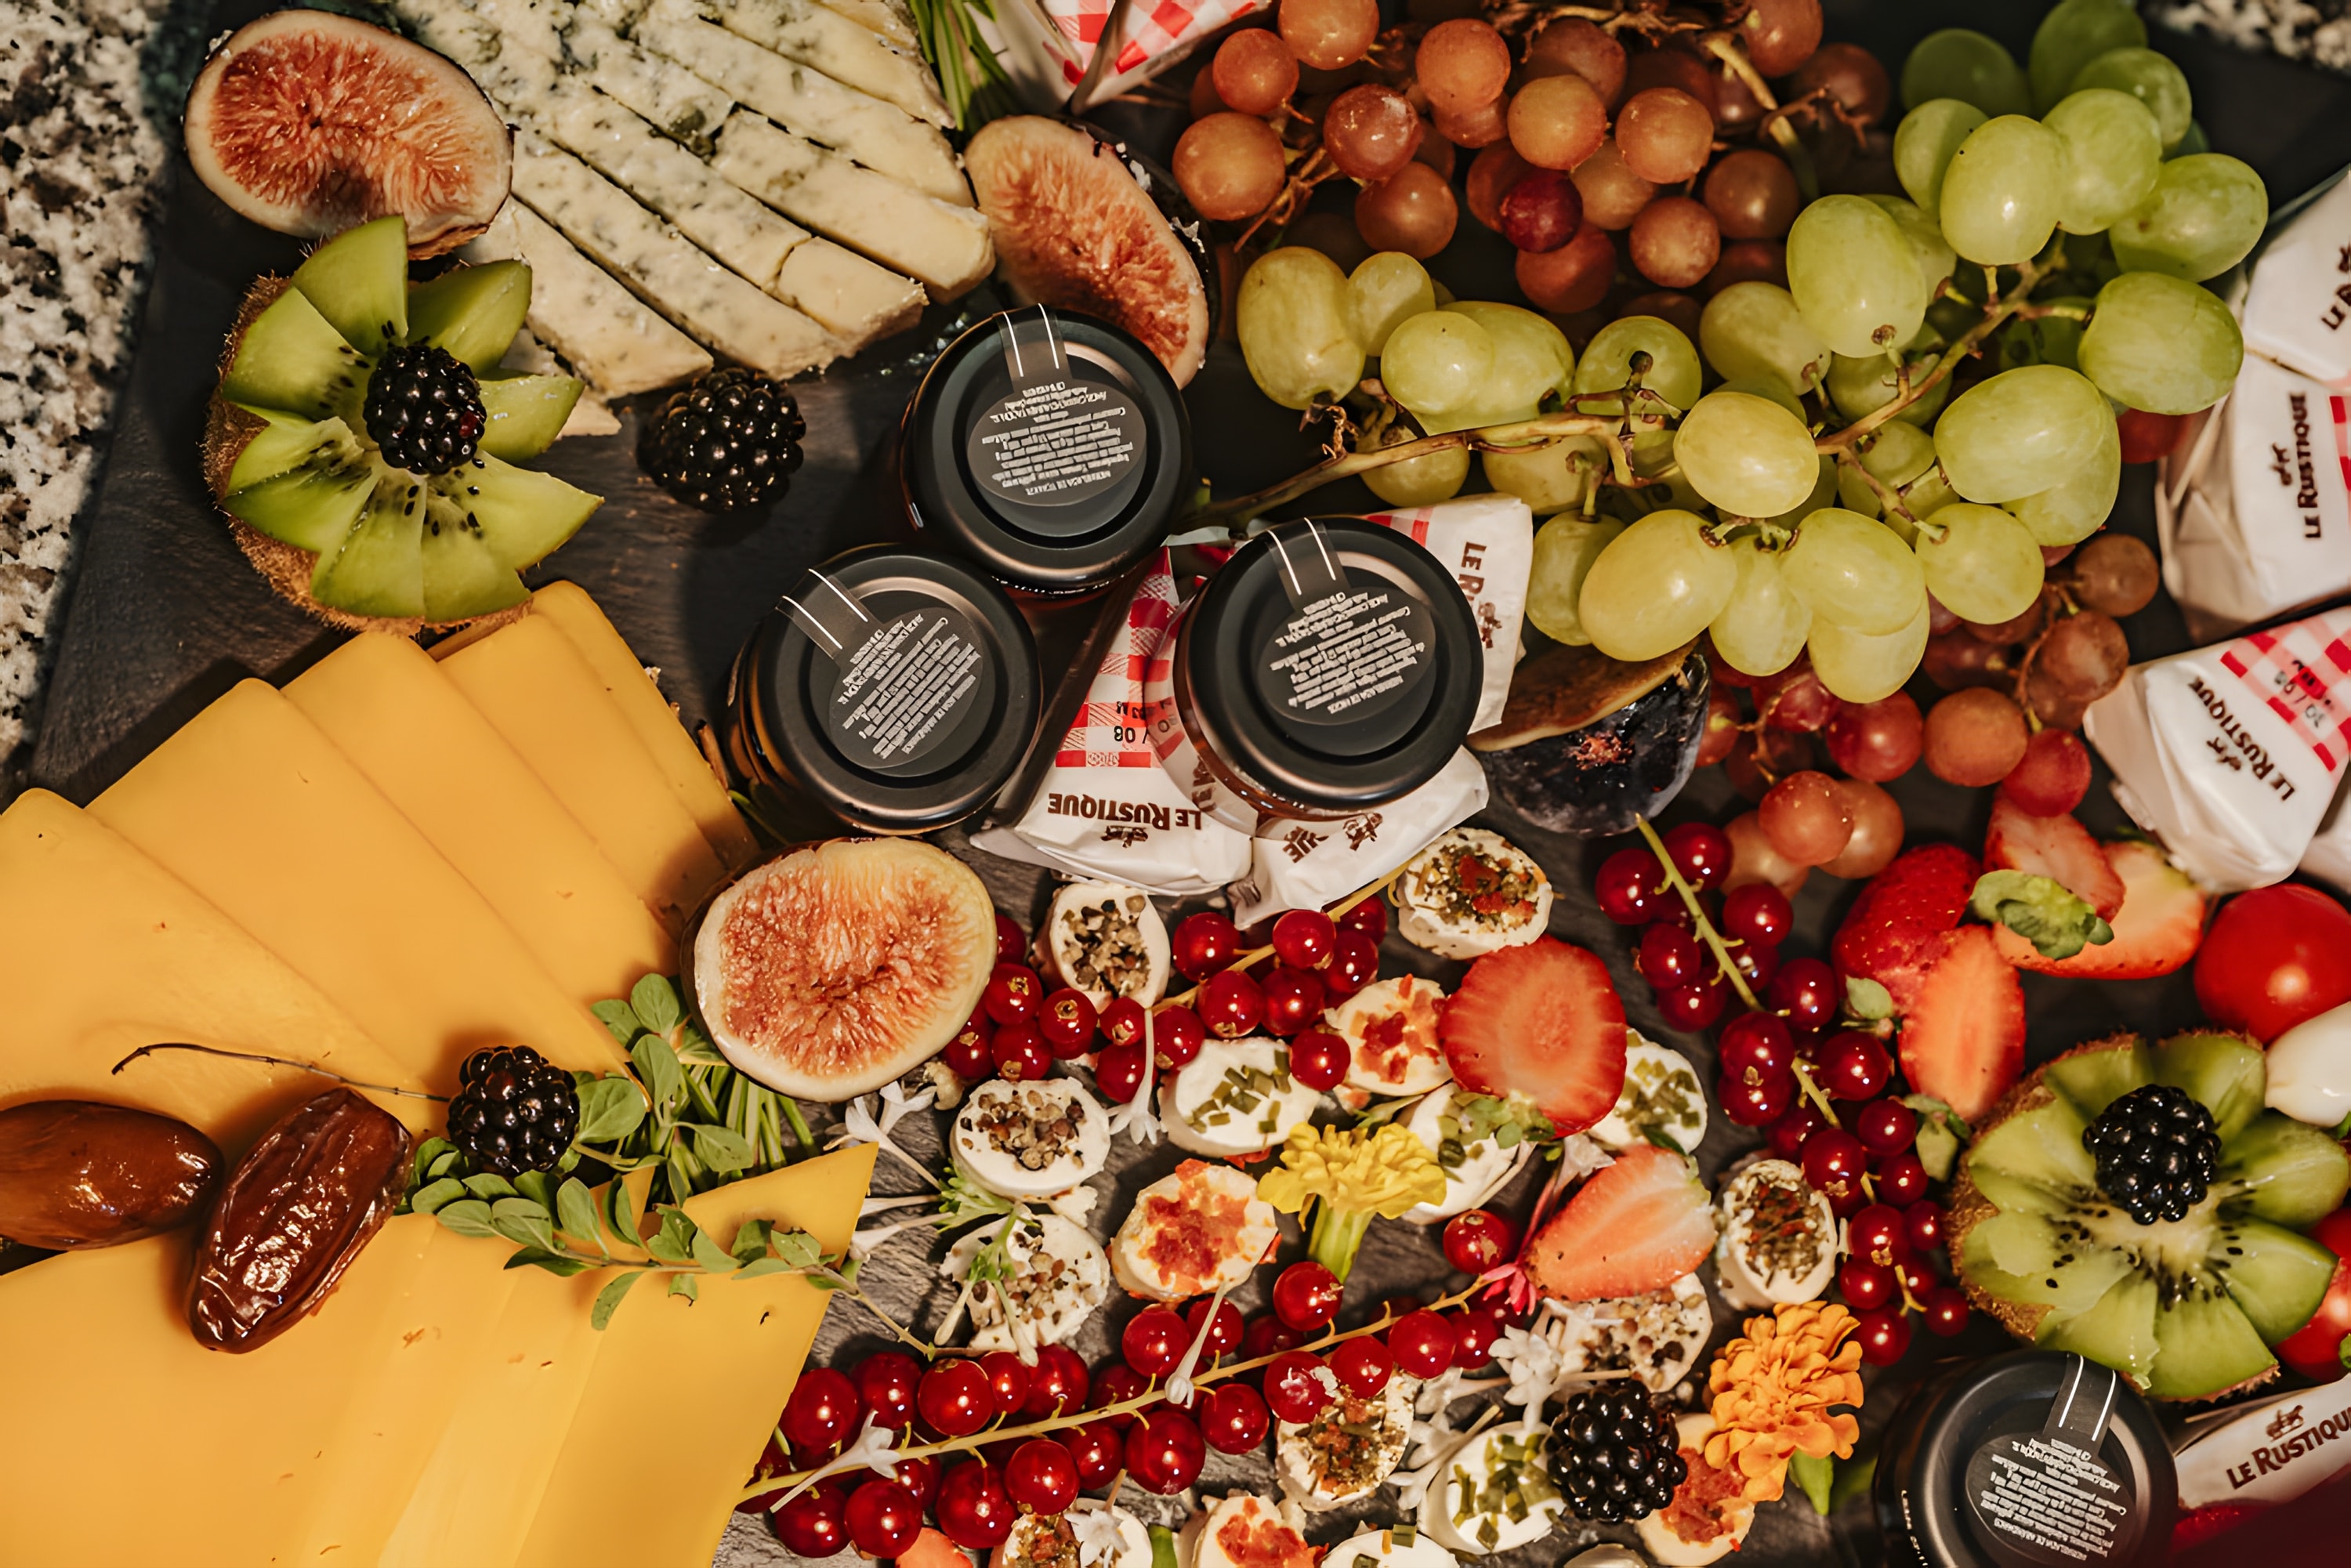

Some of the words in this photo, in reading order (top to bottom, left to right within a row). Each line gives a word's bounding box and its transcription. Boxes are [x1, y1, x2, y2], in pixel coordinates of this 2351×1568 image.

[2320, 304, 2346, 330] LE
[2290, 393, 2318, 508] RUSTIQUE
[2304, 515, 2321, 538] LE
[1461, 541, 1487, 571] LE
[2187, 675, 2275, 780] RUSTIQUE
[2270, 773, 2295, 802] LE
[1048, 792, 1171, 831] RUSTIQUE
[1175, 809, 1201, 831] LE
[2226, 1461, 2257, 1490] LE
[2251, 1407, 2351, 1476] RUSTIQU
